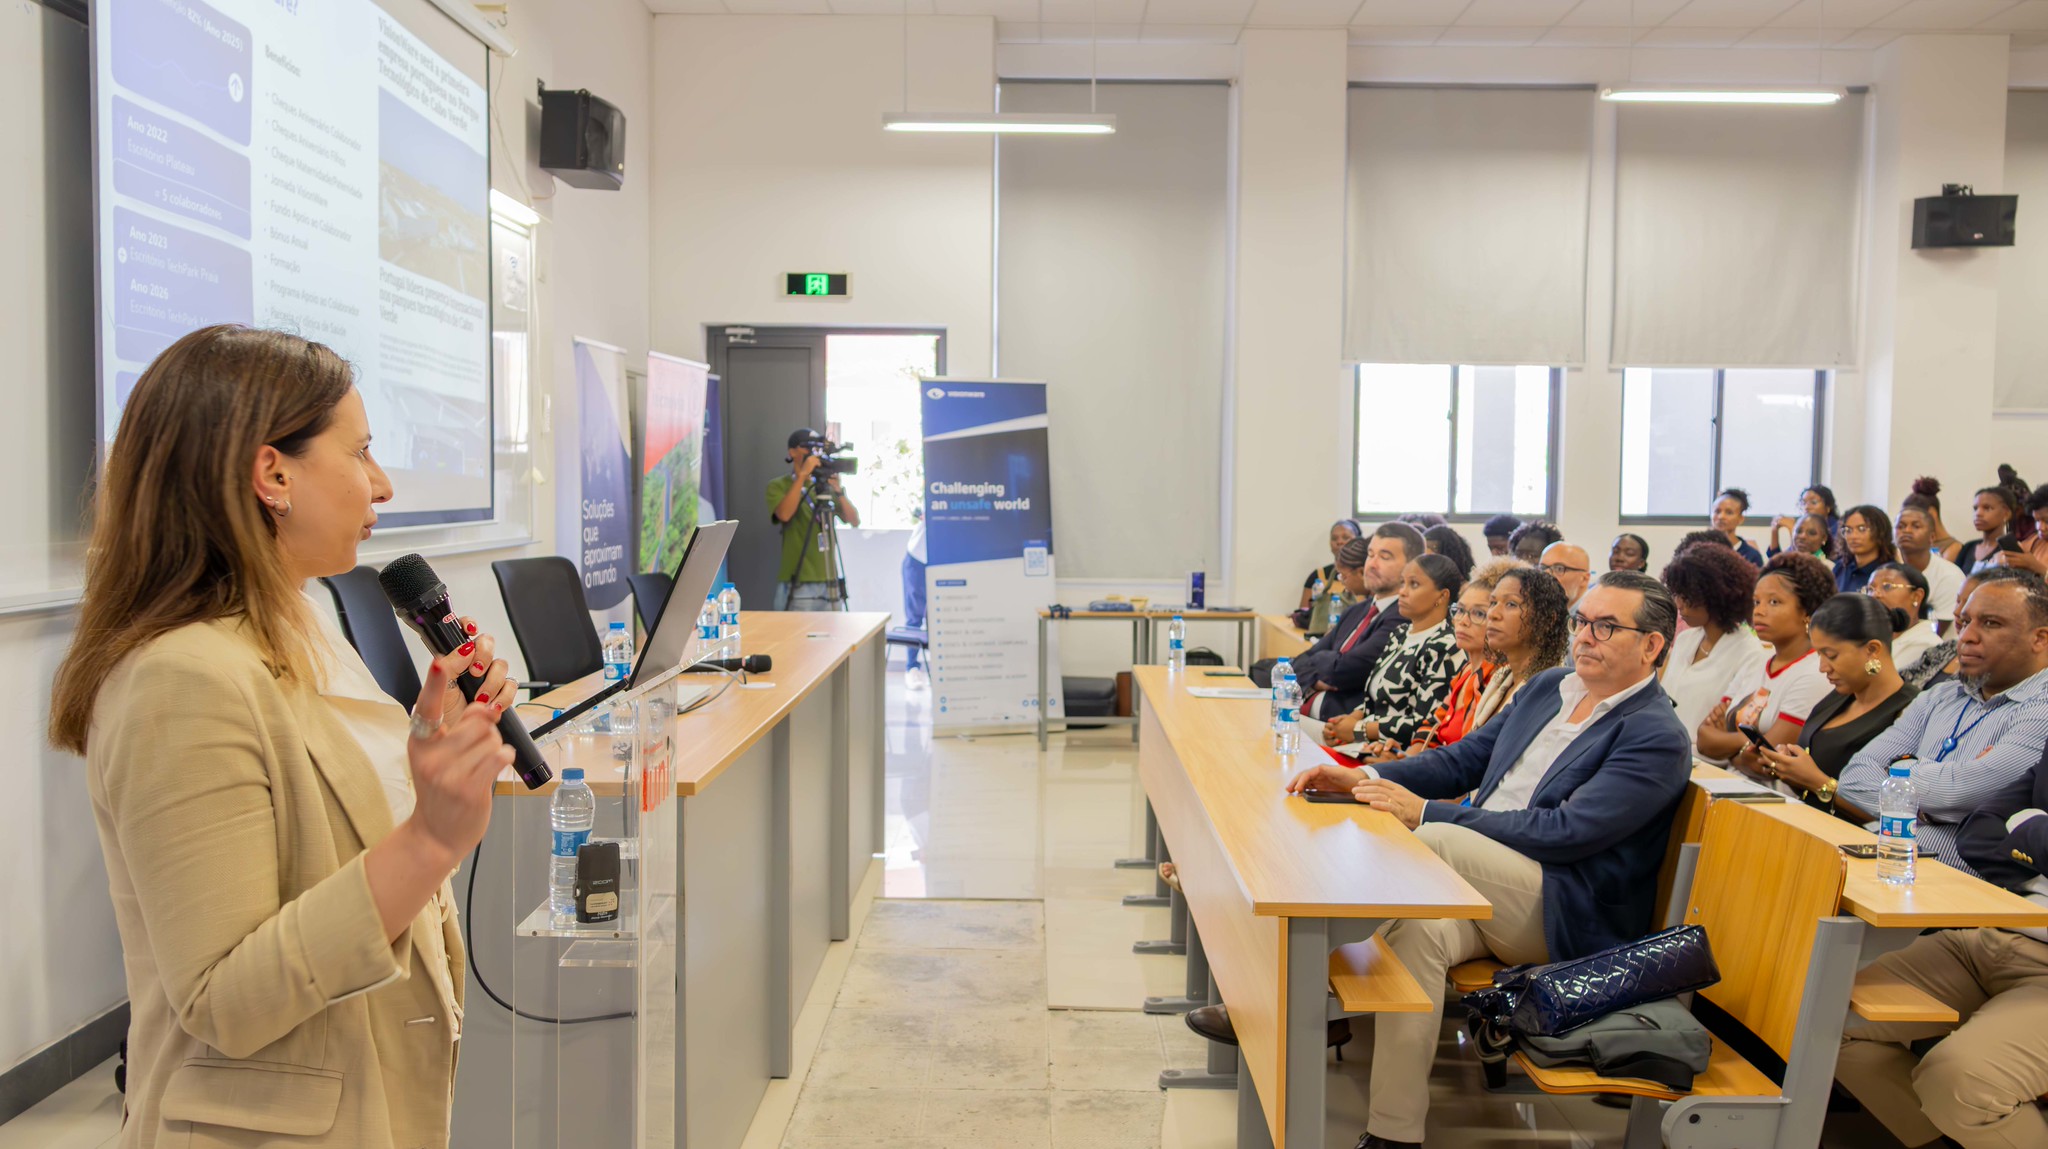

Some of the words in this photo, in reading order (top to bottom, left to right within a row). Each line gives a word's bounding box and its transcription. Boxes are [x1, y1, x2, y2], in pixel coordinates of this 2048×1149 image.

[127, 115, 145, 134] Ano
[146, 123, 168, 144] 2022
[166, 153, 195, 176] Plateau
[162, 188, 169, 202] 5
[170, 193, 223, 221] colaboradores
[129, 225, 147, 242] Ano
[148, 231, 168, 250] 2023
[167, 257, 199, 280] TechPark
[130, 278, 148, 294] Ano
[930, 482, 1006, 498] Challenging
[582, 498, 615, 522] Soluções
[931, 500, 948, 511] an
[950, 498, 992, 511] unsafe
[994, 497, 1030, 511] world
[583, 525, 599, 545] que
[584, 542, 623, 570] aproximam
[584, 571, 592, 589] o
[592, 566, 618, 587] mundo
